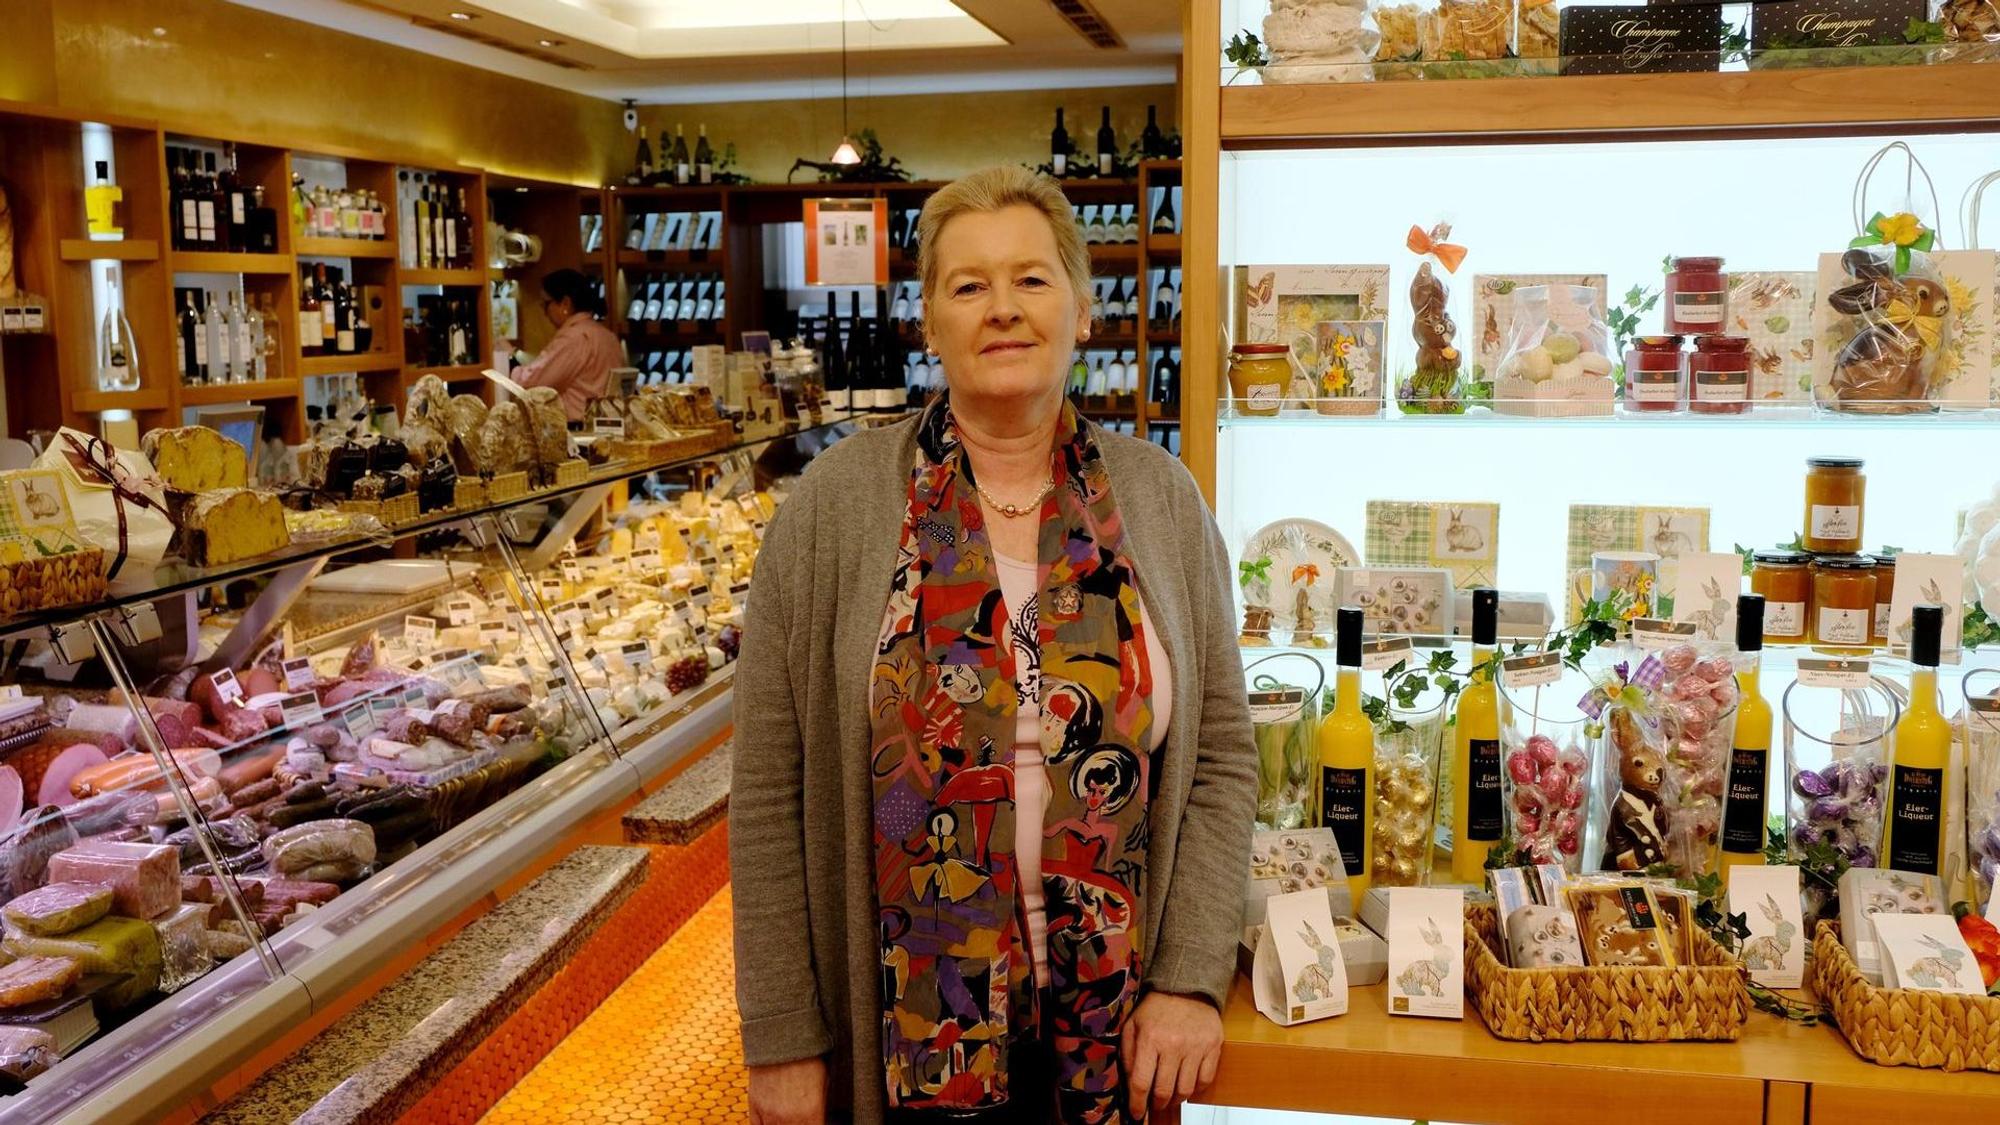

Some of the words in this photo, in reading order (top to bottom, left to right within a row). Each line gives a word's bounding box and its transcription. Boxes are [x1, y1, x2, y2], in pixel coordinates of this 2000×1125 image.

[1796, 12, 1876, 39] Champagne
[1611, 20, 1680, 46] Champagne
[1733, 783, 1755, 792] Eier-
[1332, 803, 1355, 813] Eier-
[1905, 803, 1930, 813] Eier-
[1327, 811, 1359, 821] Liqueur
[1898, 809, 1935, 821] Liqueur
